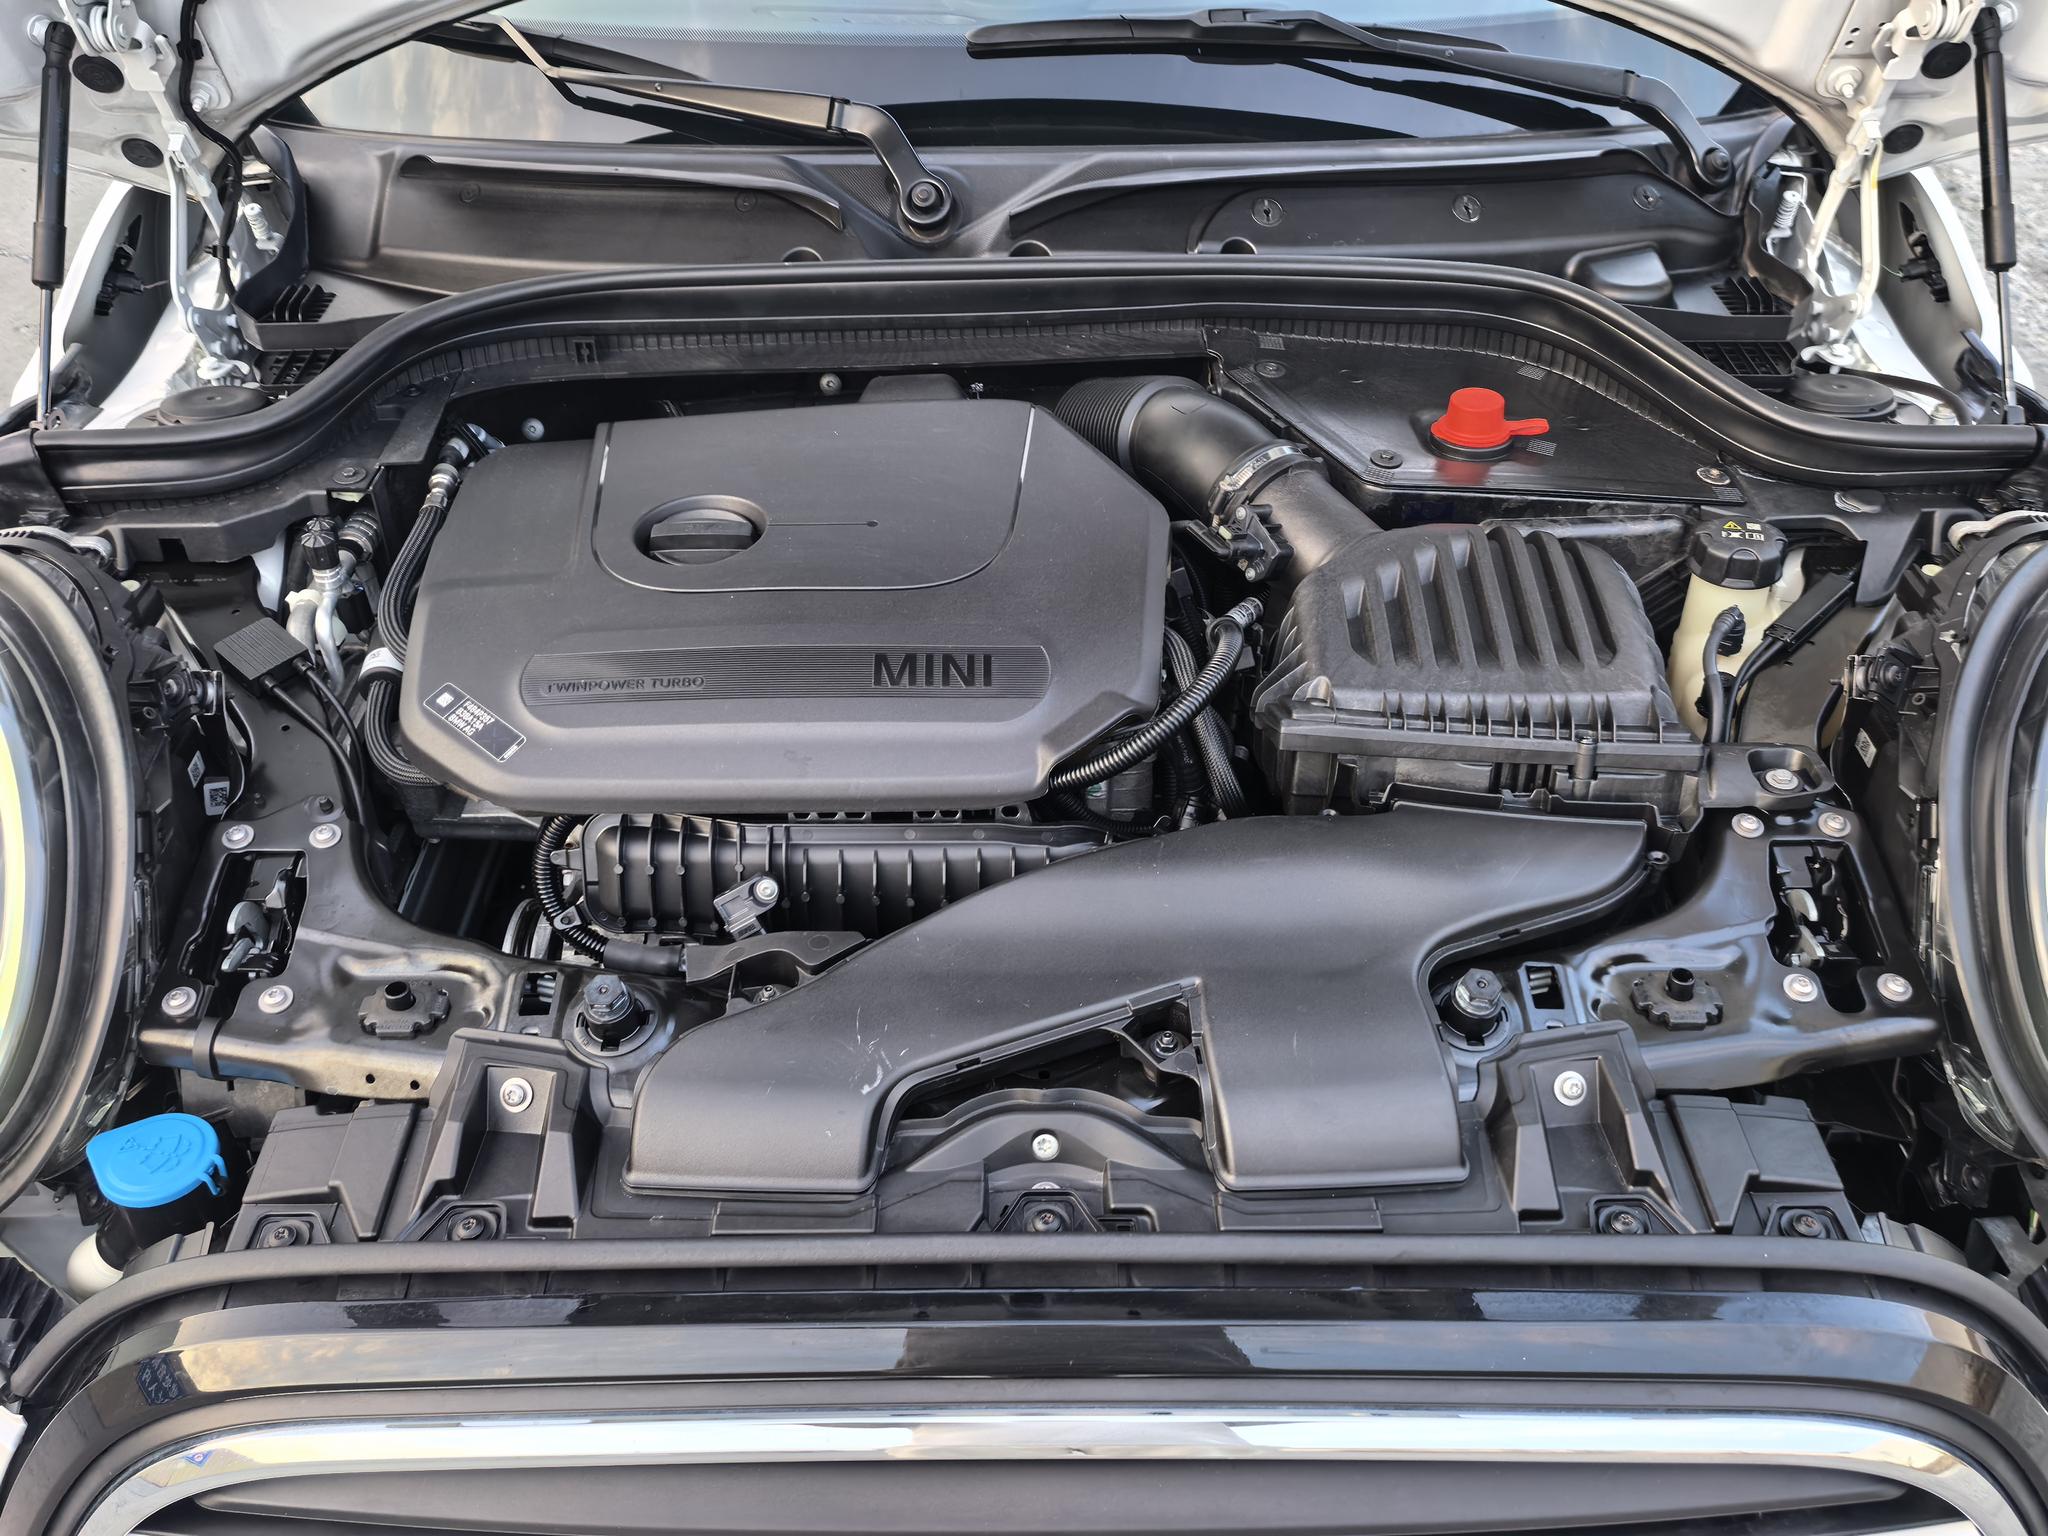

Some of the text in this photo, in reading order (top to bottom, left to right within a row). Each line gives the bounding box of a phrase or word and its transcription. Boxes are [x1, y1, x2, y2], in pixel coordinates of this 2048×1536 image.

[873, 654, 992, 687] MINI
[547, 676, 704, 693] TWINPOWER TURBO
[448, 714, 476, 737] BMW AG
